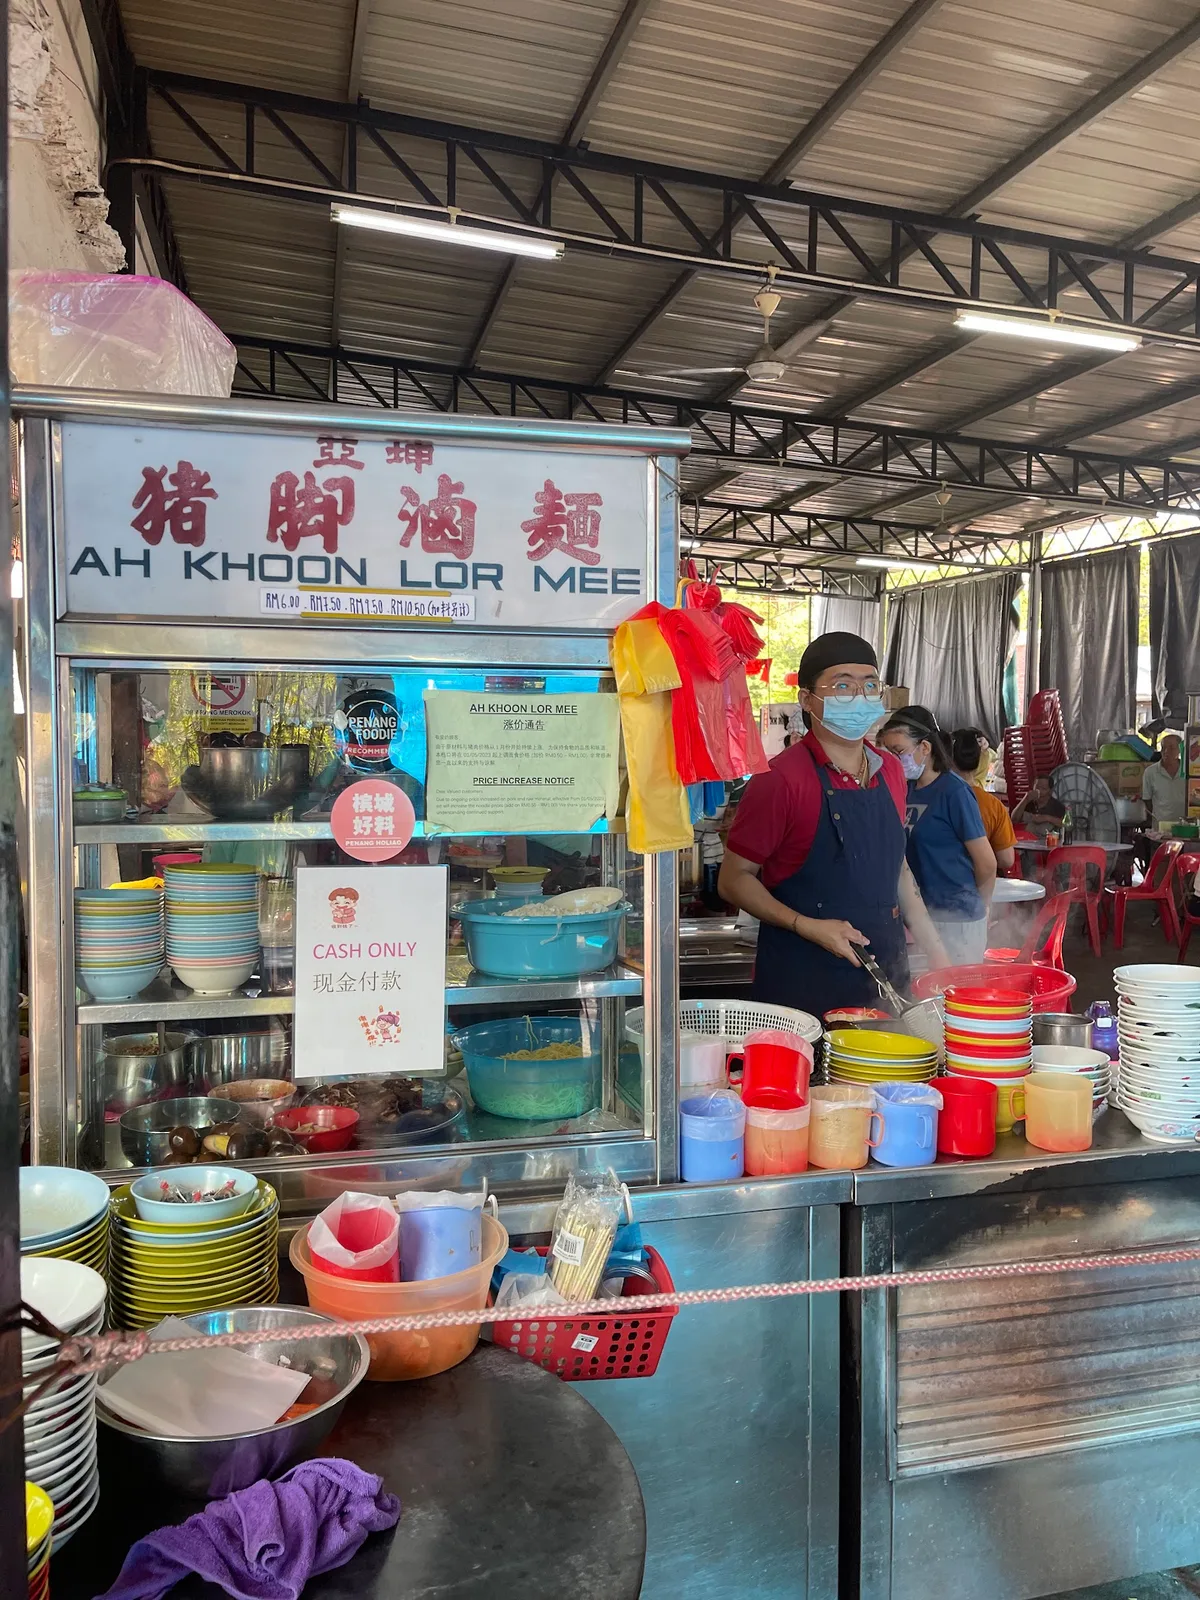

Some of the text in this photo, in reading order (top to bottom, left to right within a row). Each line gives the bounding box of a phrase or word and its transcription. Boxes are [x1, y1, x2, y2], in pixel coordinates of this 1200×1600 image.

[69, 546, 641, 595] AH KHOON LOR MEE
[265, 593, 300, 609] RM6.00
[469, 704, 578, 713] AH KHOON LOR MEE
[348, 716, 397, 728] PENANG
[503, 719, 545, 731] 涨价通告
[355, 728, 398, 740] FOODIE
[352, 815, 395, 836] 好料
[313, 942, 417, 960] CASH ONLY
[312, 970, 402, 994] 现金付款
